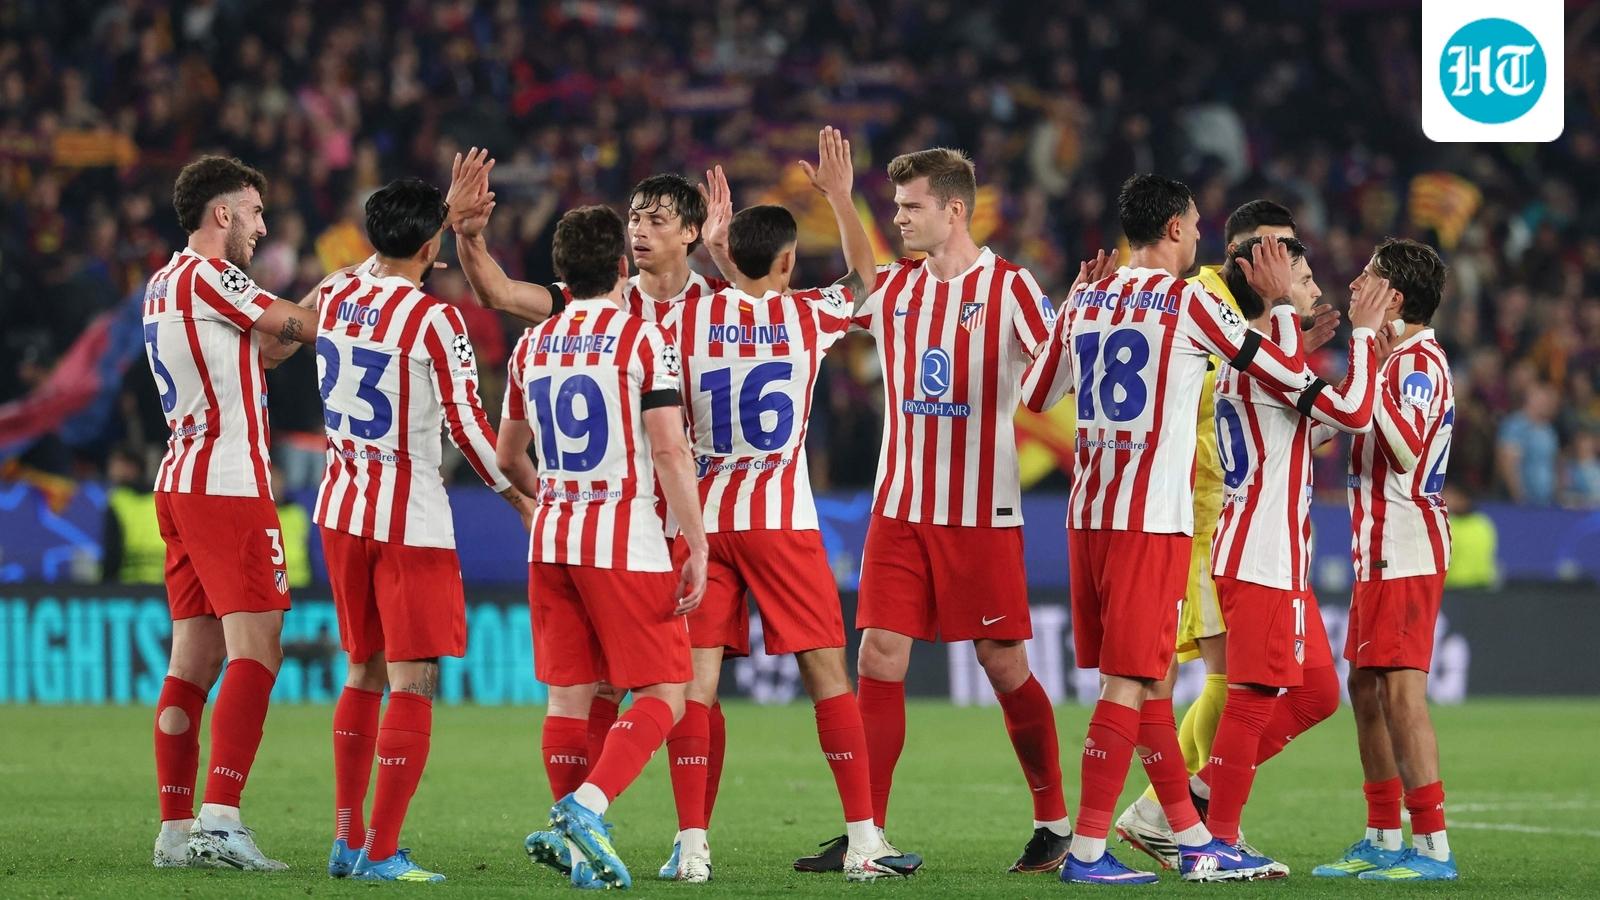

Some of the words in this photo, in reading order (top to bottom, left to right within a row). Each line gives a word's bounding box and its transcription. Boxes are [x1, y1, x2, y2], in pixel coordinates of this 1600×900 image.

[337, 301, 381, 327] NICO
[539, 334, 617, 354] ALVAREZ
[707, 324, 790, 344] MOLINA
[144, 321, 178, 413] 3
[1075, 328, 1150, 422] 18
[316, 335, 393, 440] 23
[700, 361, 795, 454] 16
[904, 400, 944, 415] RIYADH
[945, 404, 969, 416] AIR
[528, 373, 609, 472] 19
[1107, 439, 1149, 450] Children
[1215, 398, 1249, 489] 0
[359, 450, 400, 462] Children
[265, 528, 285, 566] 3
[377, 755, 407, 766] TLETI
[550, 754, 588, 766] ATLETI
[676, 756, 708, 766] ATLETI
[213, 765, 243, 782] ATLETI
[161, 785, 191, 796] ATLETI
